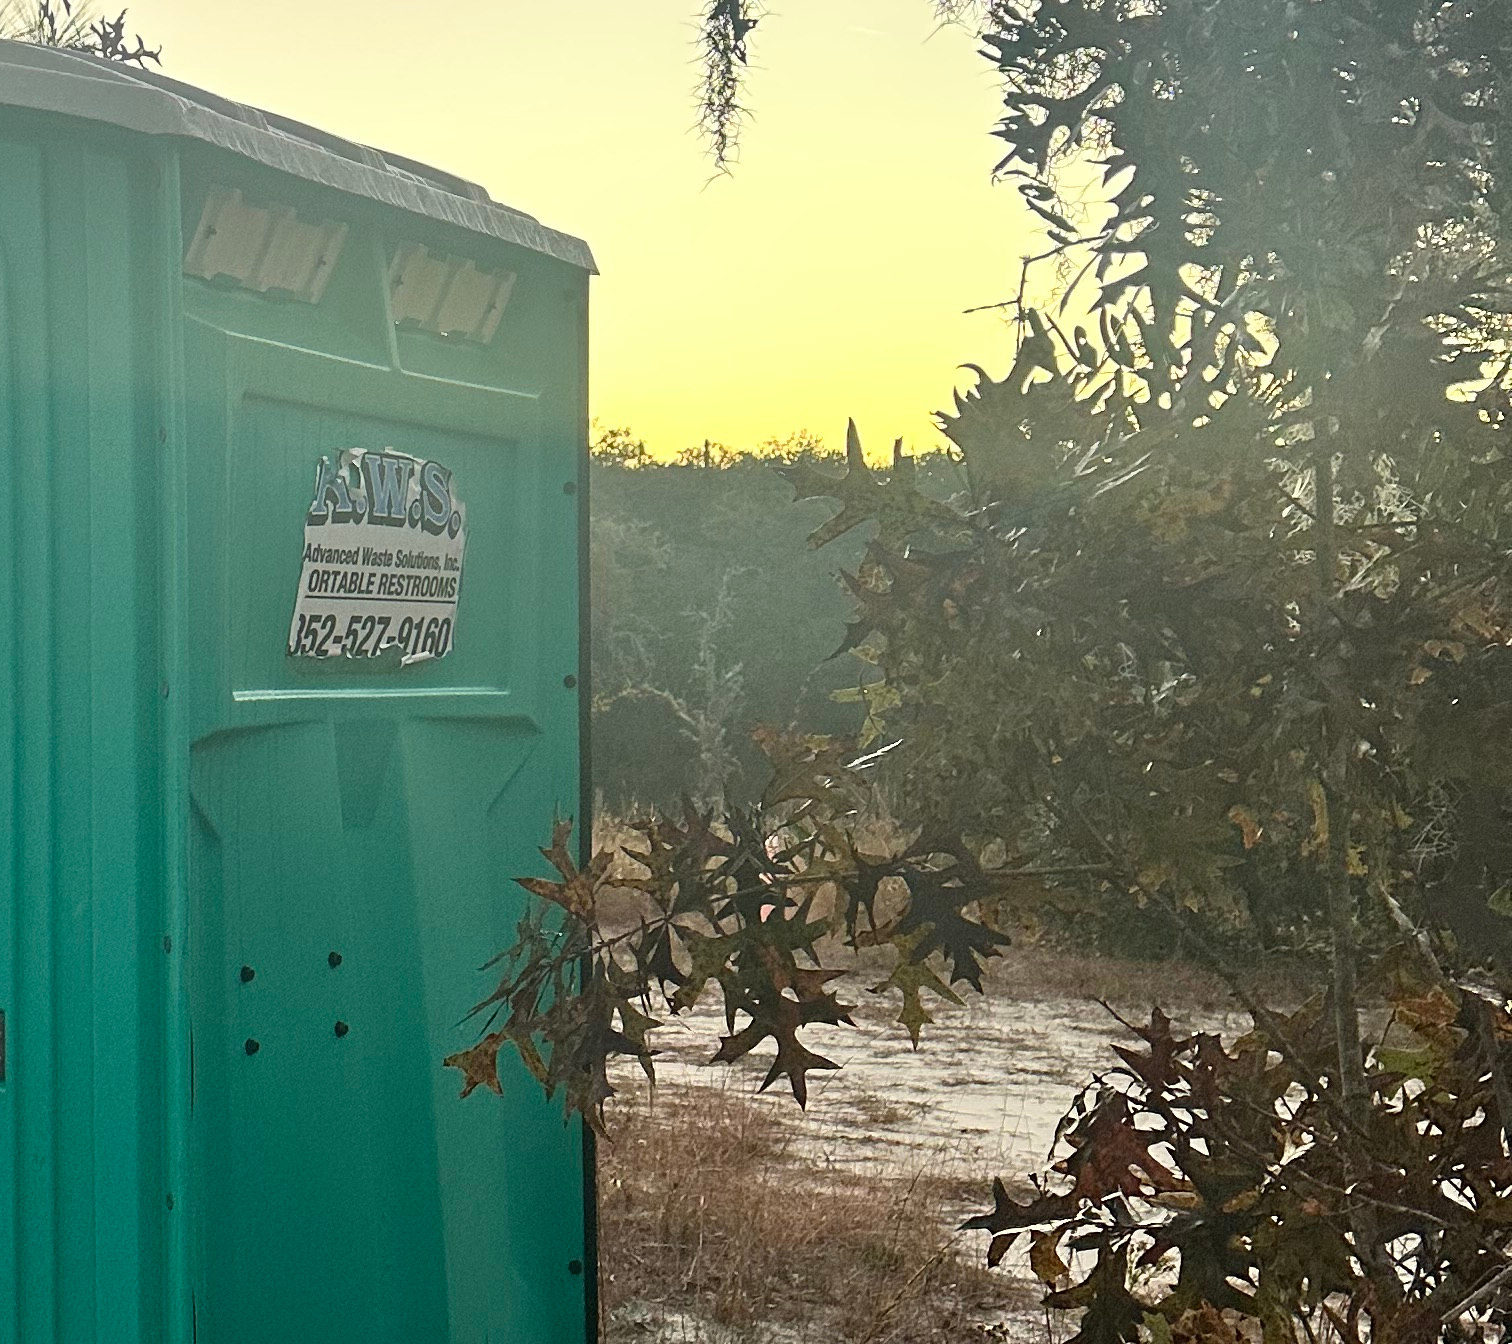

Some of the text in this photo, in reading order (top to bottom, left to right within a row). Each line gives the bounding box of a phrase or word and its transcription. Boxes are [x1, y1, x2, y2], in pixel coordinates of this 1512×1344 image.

[303, 543, 460, 573] Advanced Waste Solutions, Inc.
[308, 569, 457, 598] ORTABLE RESTROOMS
